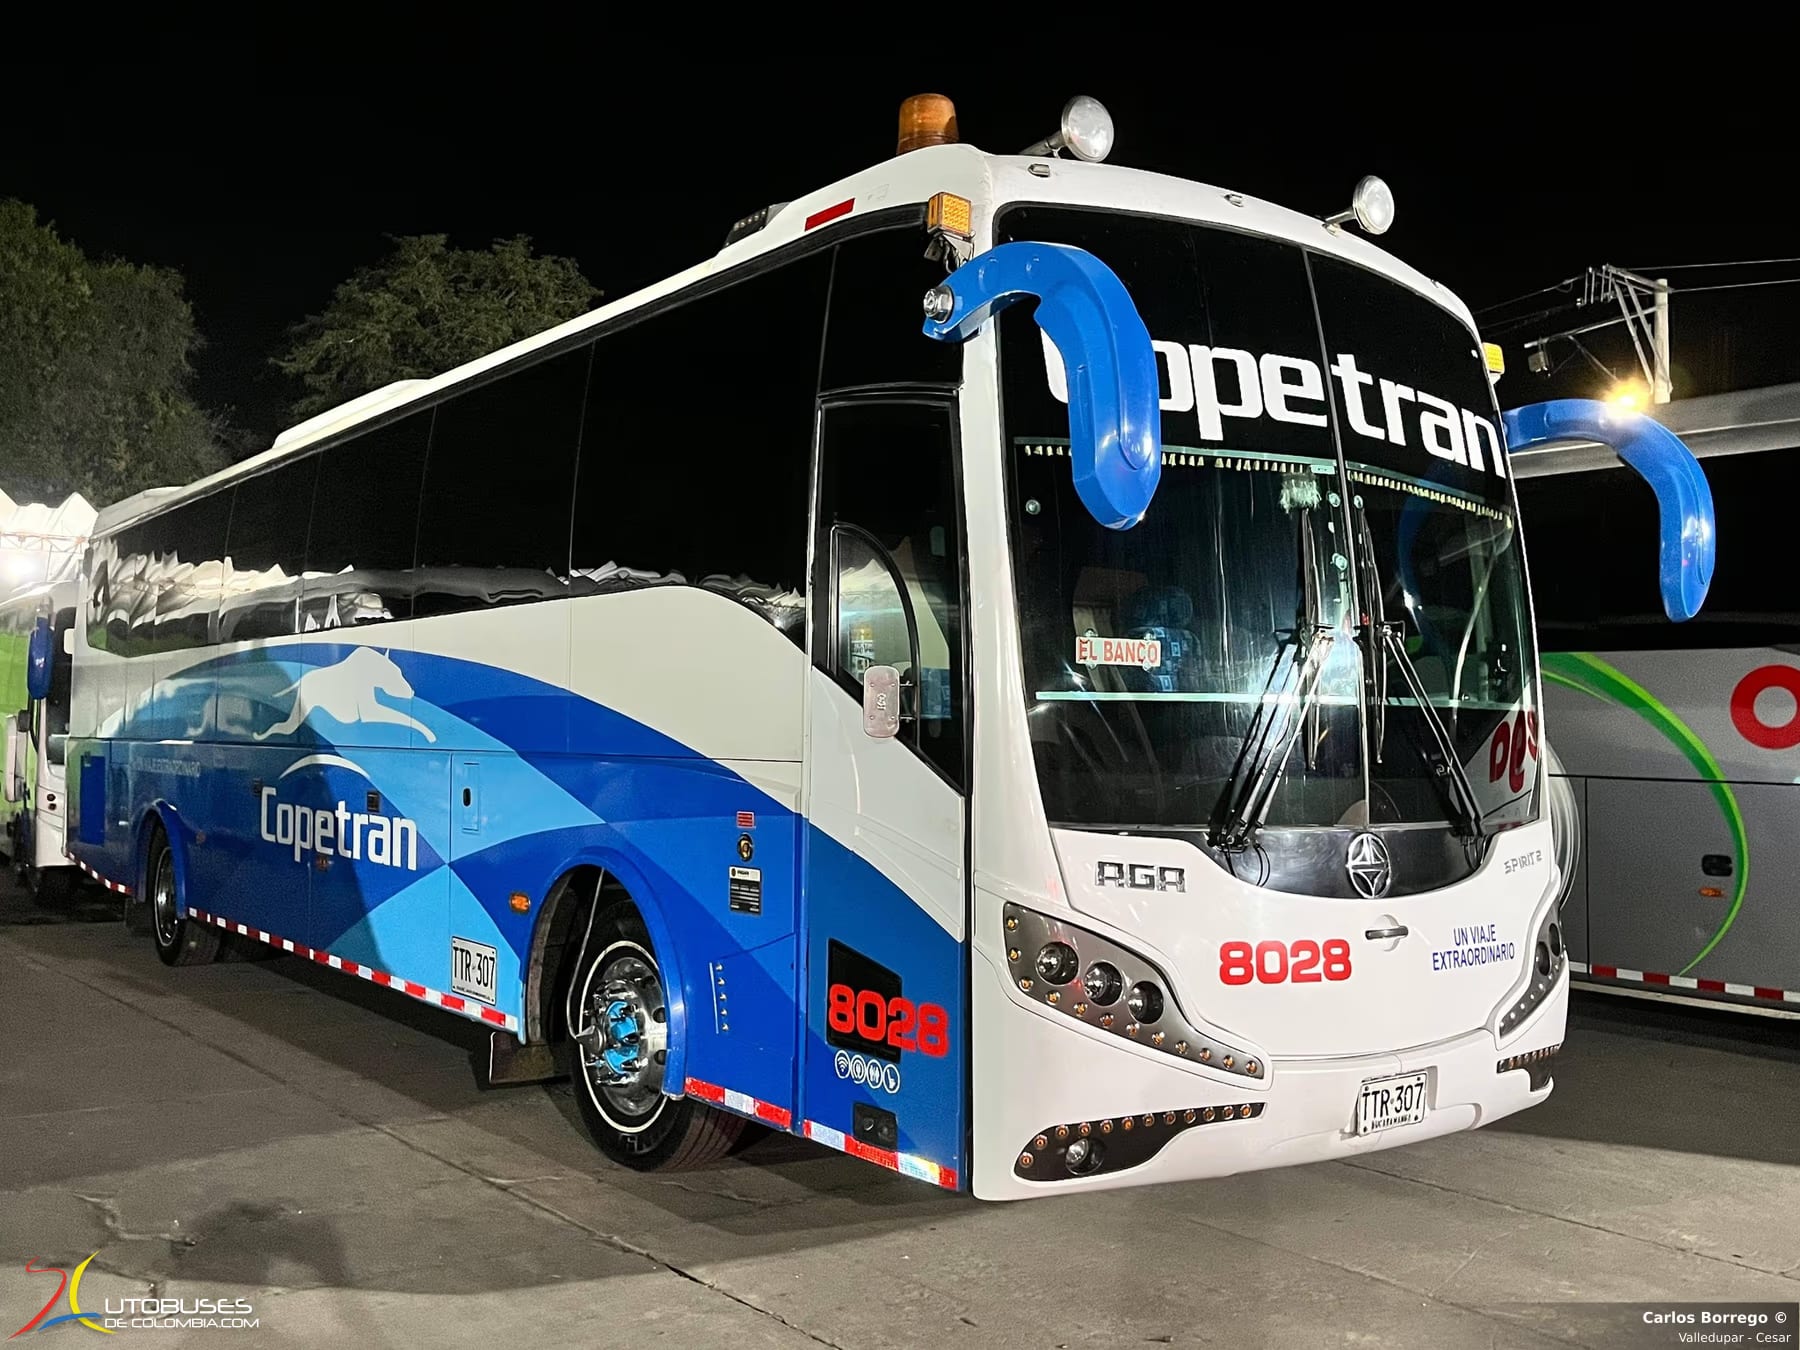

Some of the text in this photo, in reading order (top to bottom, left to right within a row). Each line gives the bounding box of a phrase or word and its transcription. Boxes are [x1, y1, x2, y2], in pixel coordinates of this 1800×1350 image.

[1079, 640, 1158, 664] EL BANCO
[260, 786, 418, 871] Copetran
[1504, 851, 1534, 875] SPIRIT
[1453, 924, 1497, 946] UN VIAJE
[1219, 938, 1352, 986] 8028
[1432, 942, 1515, 971] EXTRAORDINARIO
[828, 983, 950, 1057] 8028
